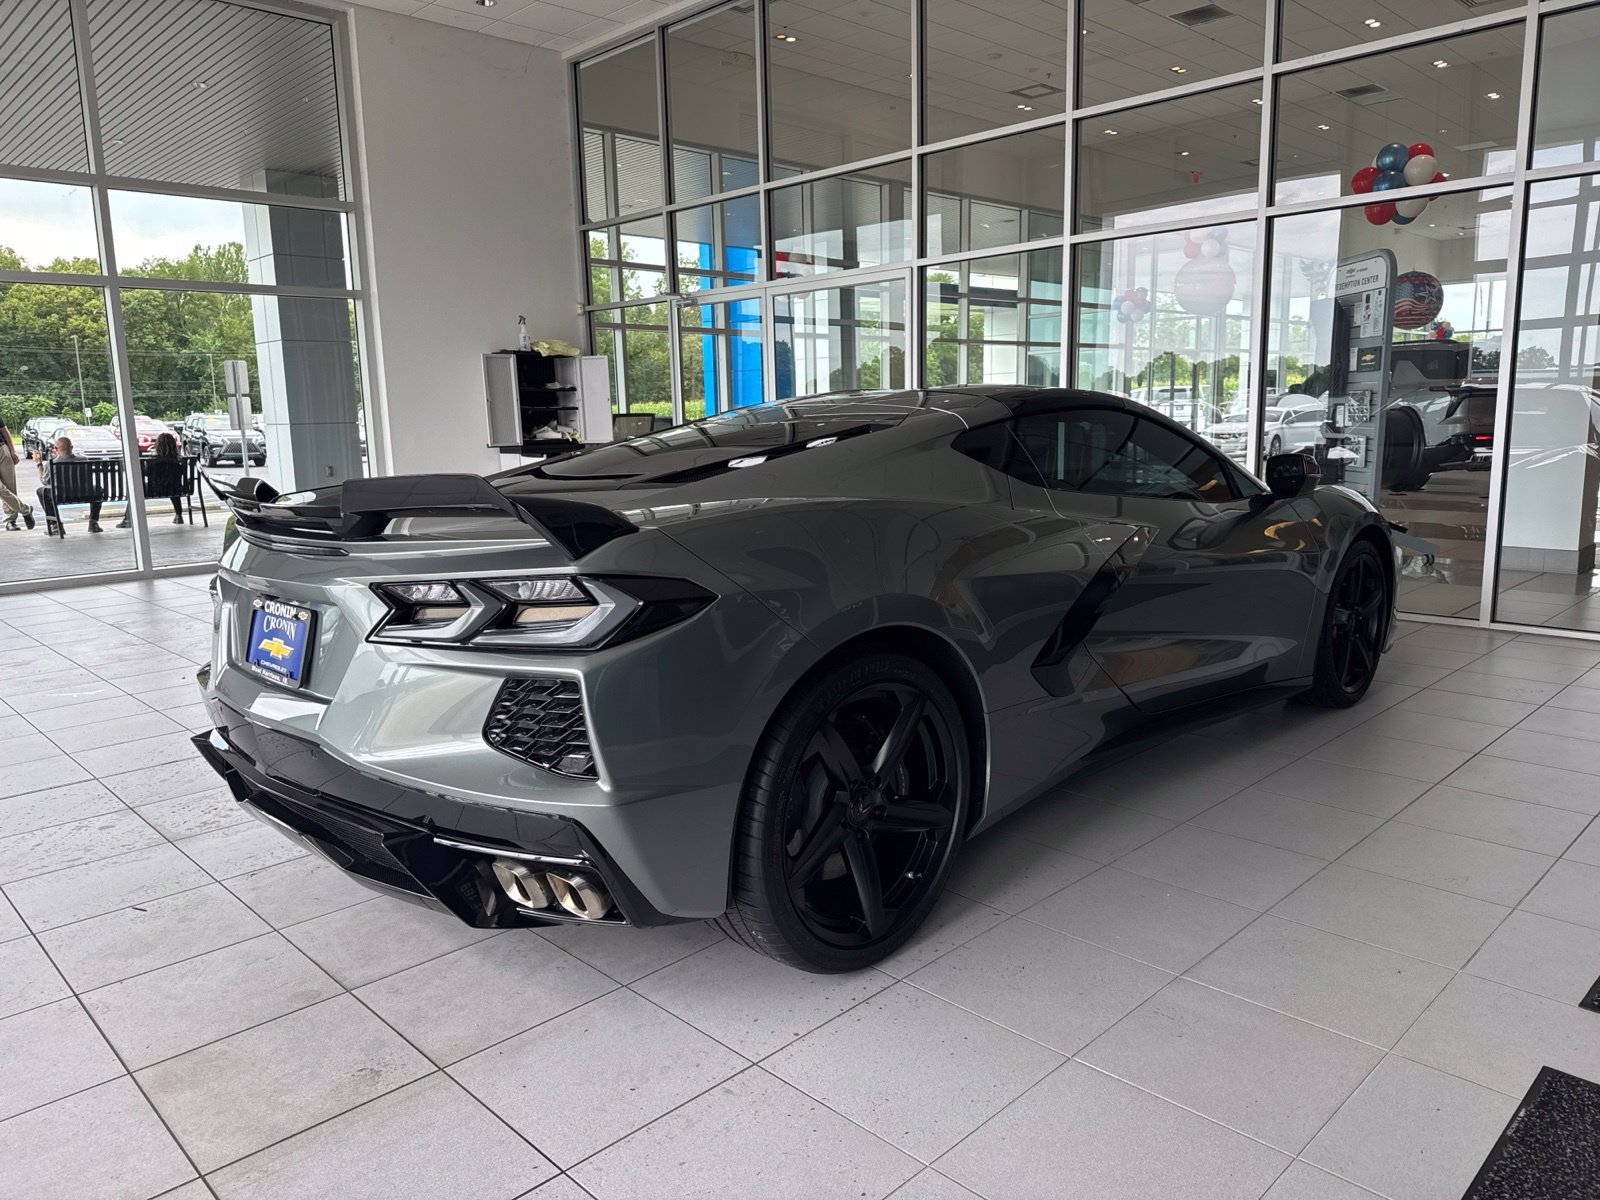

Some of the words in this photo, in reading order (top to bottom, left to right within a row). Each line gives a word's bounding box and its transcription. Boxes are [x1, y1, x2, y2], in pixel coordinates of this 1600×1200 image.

[1336, 279, 1360, 291] EDEMPTION
[1361, 274, 1379, 285] CENTER
[264, 600, 297, 619] CRONIN
[263, 614, 297, 641] CRONIN
[260, 659, 287, 673] CHEVROLET
